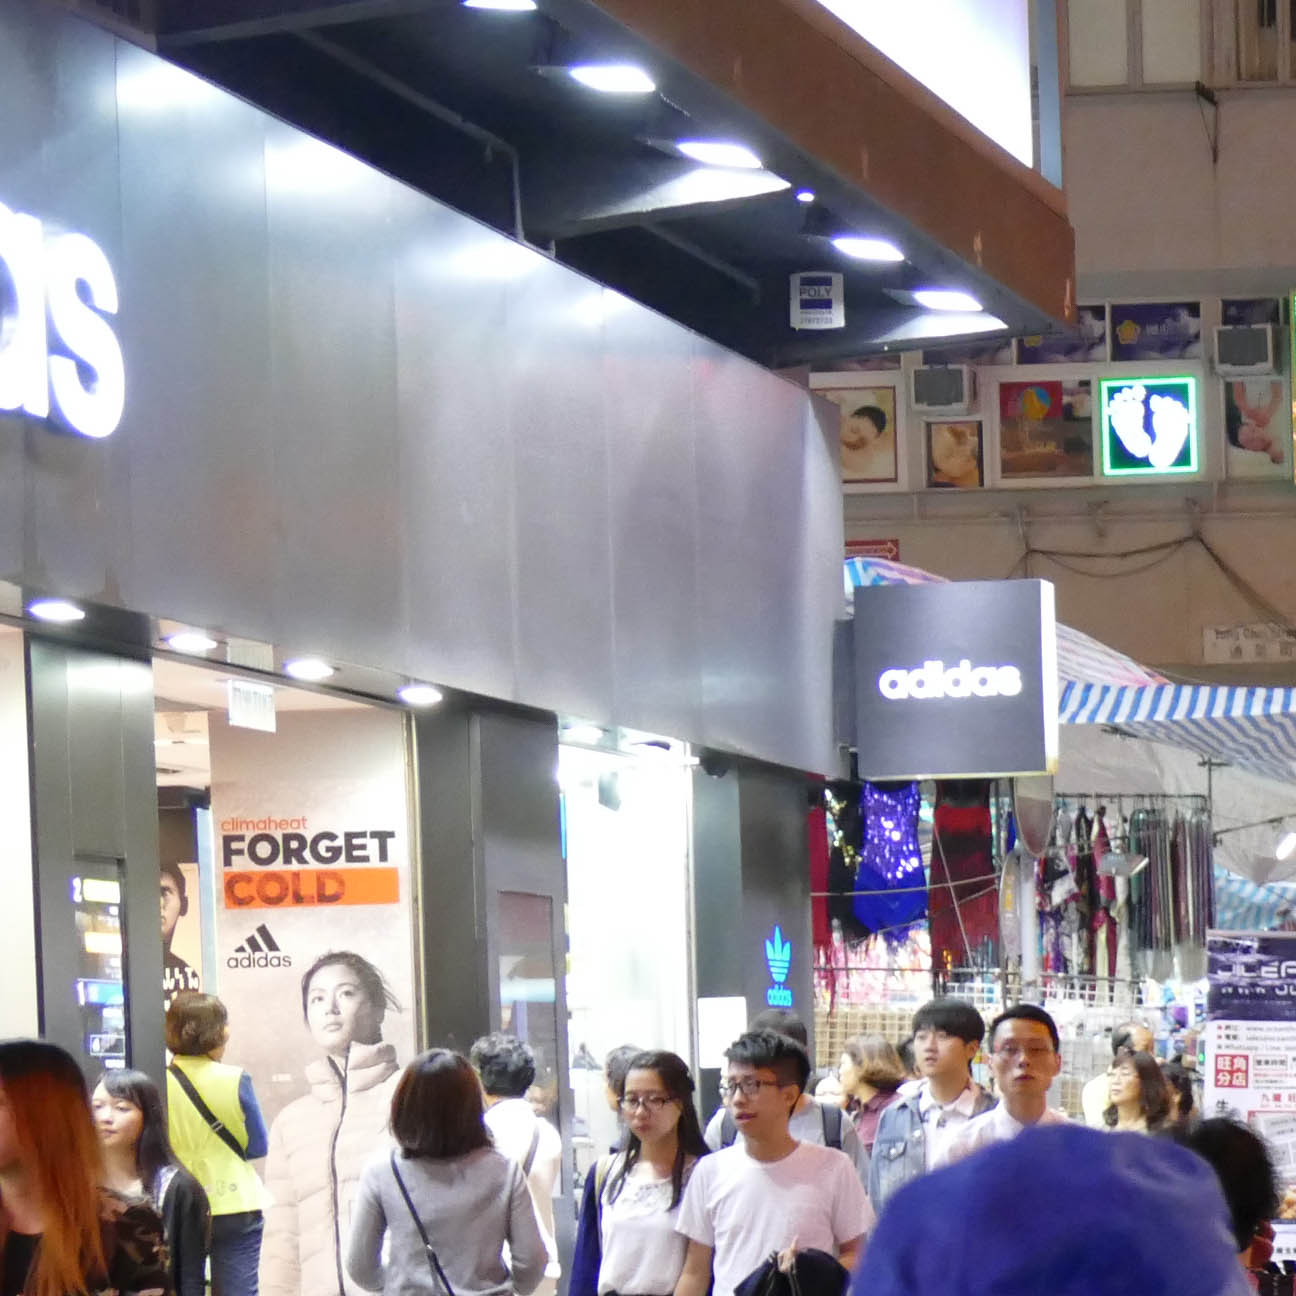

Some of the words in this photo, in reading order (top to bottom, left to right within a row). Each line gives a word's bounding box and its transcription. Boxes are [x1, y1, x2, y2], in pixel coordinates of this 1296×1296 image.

[878, 659, 1022, 700] adidas
[221, 816, 308, 833] climaheat
[222, 830, 396, 867] FORGET
[225, 871, 346, 906] COLD
[227, 951, 292, 969] adidas
[767, 984, 793, 1007] adidas
[1216, 1056, 1248, 1070] 旺角
[1216, 1072, 1248, 1088] 分店
